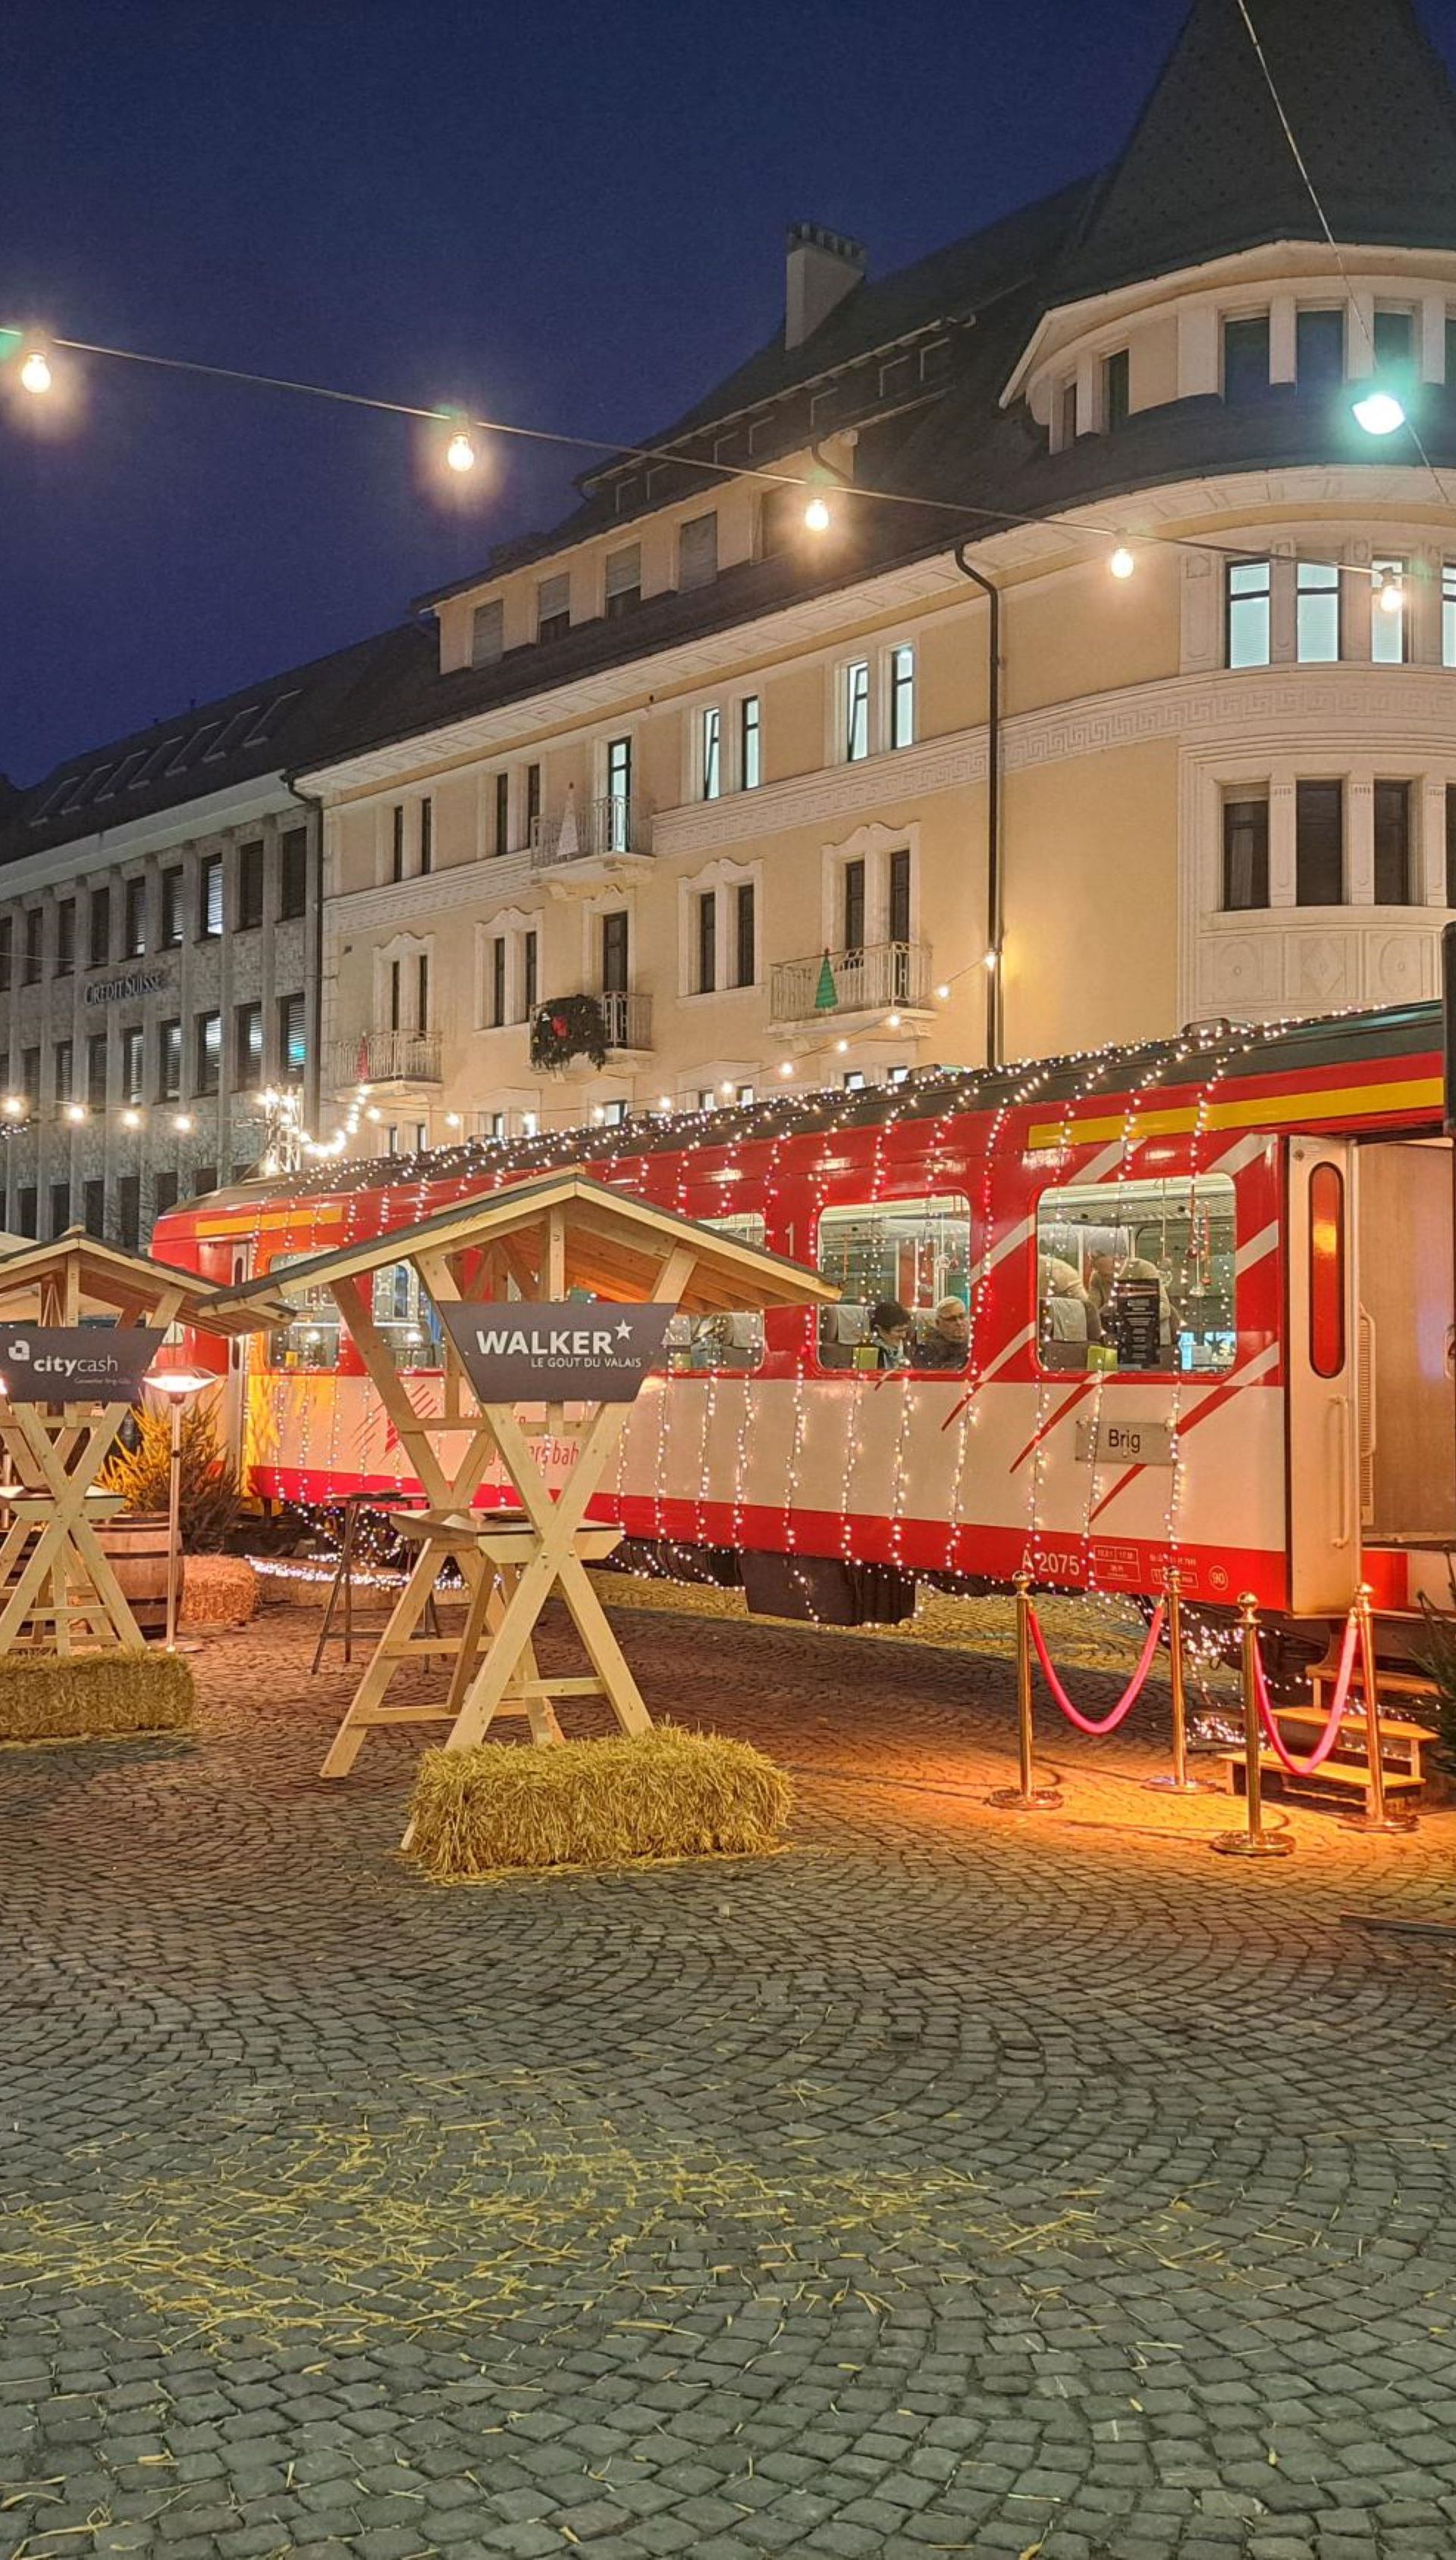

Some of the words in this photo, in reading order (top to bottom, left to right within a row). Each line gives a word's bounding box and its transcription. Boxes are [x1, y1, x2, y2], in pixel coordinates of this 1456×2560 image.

[84, 981, 124, 1006] CREDIT
[475, 1330, 614, 1355] WALKER
[33, 1355, 118, 1377] citycash
[531, 1357, 544, 1368] LE
[584, 1358, 601, 1368] DU
[604, 1357, 642, 1368] VALAIS
[1109, 1428, 1141, 1453] Brig
[1038, 1552, 1081, 1575] 2075
[1213, 1571, 1225, 1585] 90
